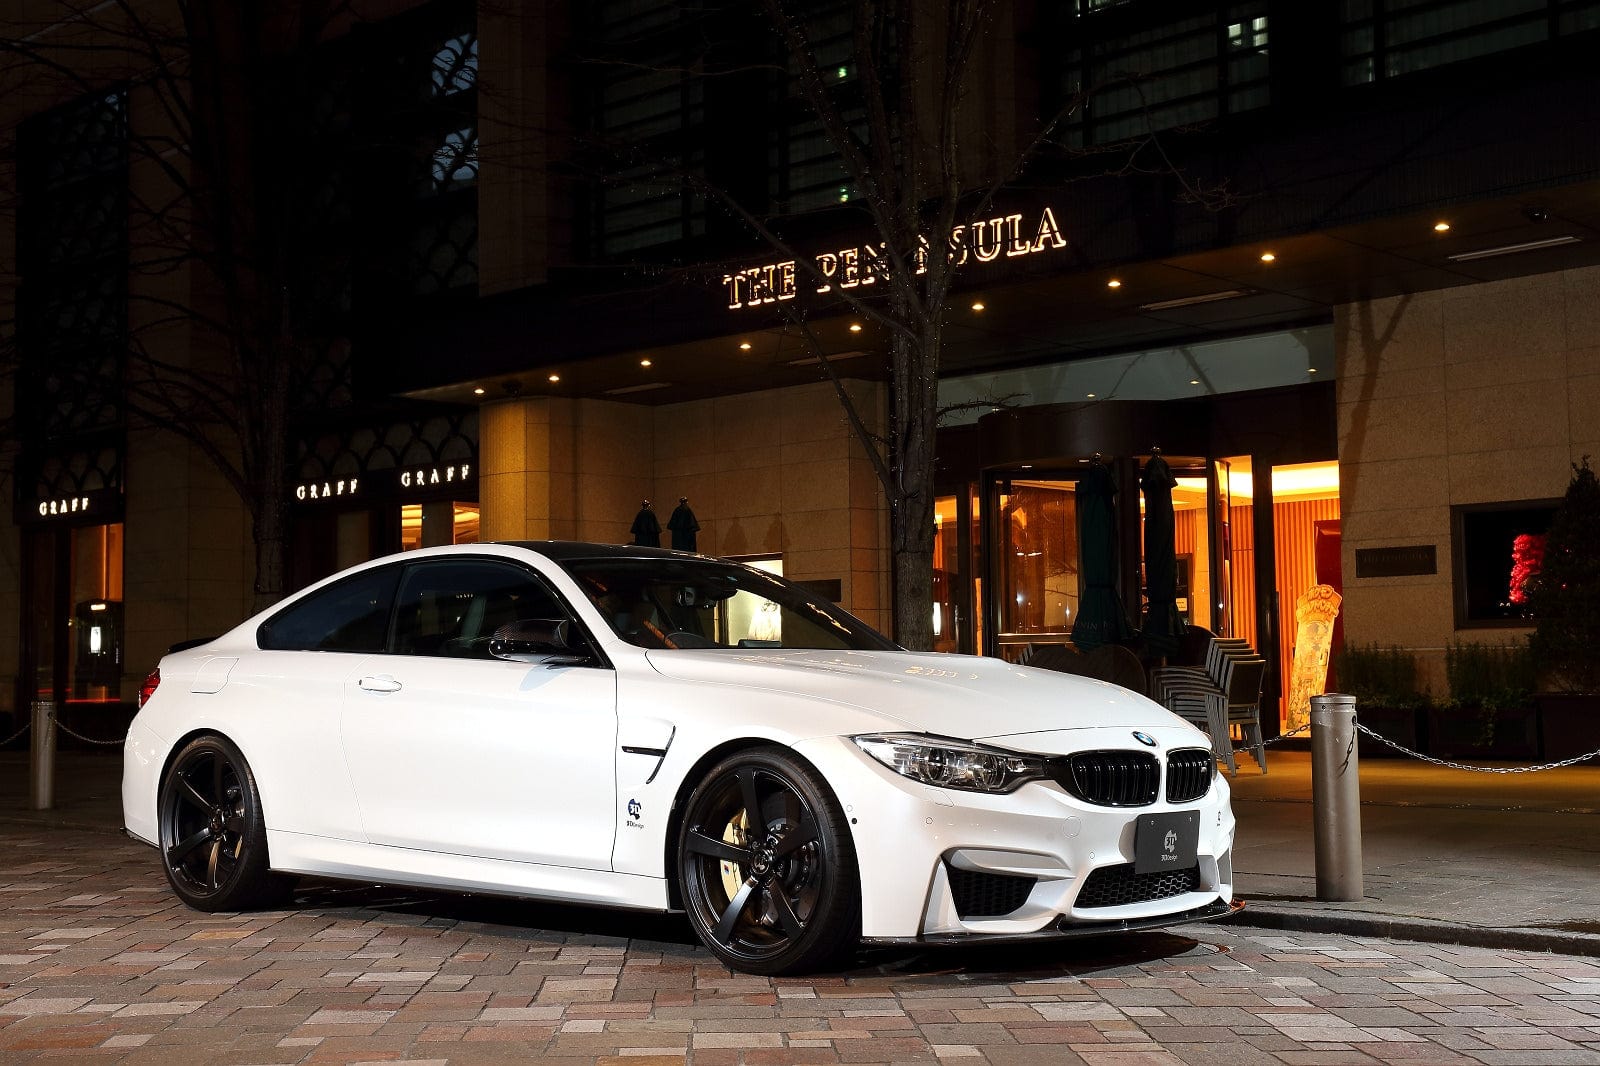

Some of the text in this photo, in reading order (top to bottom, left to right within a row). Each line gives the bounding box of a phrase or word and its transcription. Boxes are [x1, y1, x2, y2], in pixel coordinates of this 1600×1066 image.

[723, 207, 1067, 308] THE PENSULA
[400, 464, 470, 487] GRAFF
[296, 479, 358, 500] GRAFF
[39, 497, 89, 516] GRAFF
